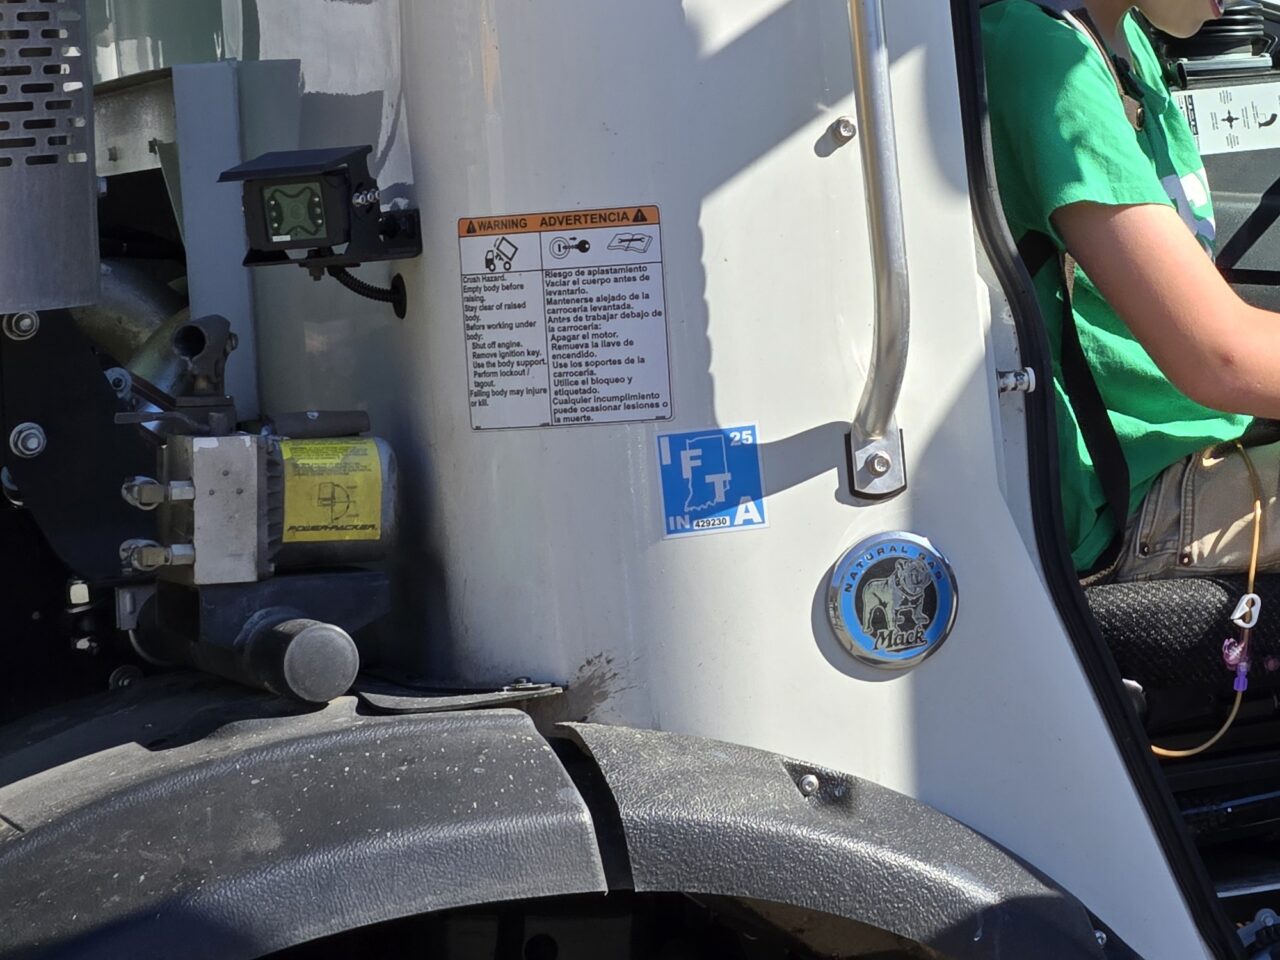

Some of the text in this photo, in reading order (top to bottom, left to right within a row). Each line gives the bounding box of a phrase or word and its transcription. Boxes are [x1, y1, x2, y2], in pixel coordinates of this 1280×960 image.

[477, 218, 528, 230] WARNING
[540, 212, 630, 227] ADVERTENCIA
[545, 270, 572, 279] Riesgo
[587, 265, 647, 277] aplastamiento
[545, 279, 570, 287] Vaciar
[613, 275, 636, 283] antes
[463, 282, 524, 294] Empty body before
[545, 287, 588, 296] levantarlo.
[464, 294, 487, 304] raising.
[546, 296, 593, 305] Mantenerse
[596, 293, 626, 303] alejado
[629, 292, 639, 300] de
[464, 301, 526, 313] Stay clear of raised
[590, 303, 633, 312] levantada.
[465, 314, 481, 323] body.
[548, 309, 662, 323] Antes de trabajar debajo de
[486, 321, 513, 330] working
[515, 320, 536, 328] under
[551, 333, 579, 342] Apagar
[591, 331, 618, 340] motor.
[472, 340, 523, 350] Shut off engine.
[551, 342, 589, 350] Remueva
[601, 339, 621, 348] llave
[623, 338, 634, 346] de
[472, 348, 542, 359] Remove ignition key.
[552, 350, 597, 360] encendido.
[486, 360, 496, 368] the
[498, 360, 514, 368] body
[516, 358, 548, 367] support.
[552, 356, 645, 369] Use los soportes de la
[474, 370, 498, 378] Perform
[500, 368, 525, 377] lockout
[474, 380, 496, 389] tagout.
[554, 378, 579, 387] Utilice
[591, 377, 625, 386] bloqueo
[627, 376, 633, 384] y
[470, 386, 547, 398] Falling body may injure
[554, 387, 600, 397] etiquetado.
[478, 399, 489, 407] kill.
[553, 392, 660, 406] Cualquier incumplimiento
[554, 406, 578, 415] puede
[580, 404, 622, 413] ocasionar
[624, 401, 660, 410] lesiones
[554, 415, 560, 423] la
[730, 430, 753, 446] 25
[668, 514, 690, 530] IN
[695, 517, 727, 528] 429230
[845, 546, 908, 593] NATURAL
[874, 625, 928, 652] Mack
